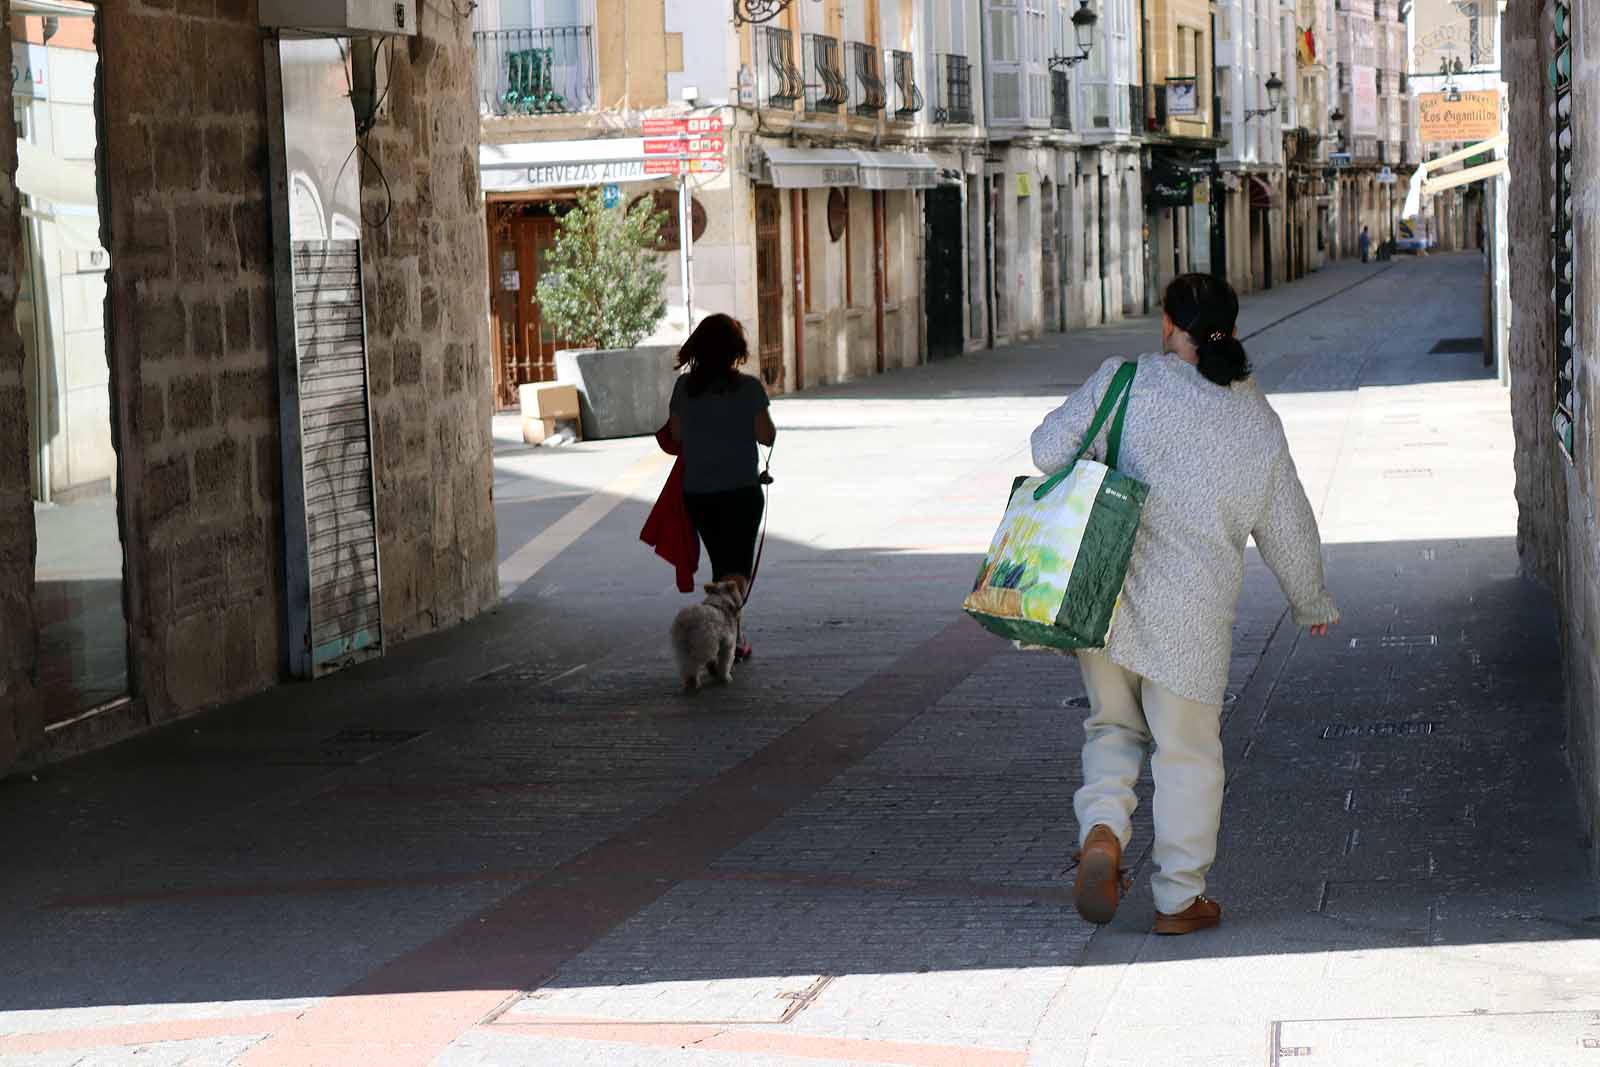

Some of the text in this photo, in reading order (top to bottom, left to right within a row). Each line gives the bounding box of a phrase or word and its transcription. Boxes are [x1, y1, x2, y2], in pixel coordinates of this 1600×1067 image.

[1424, 107, 1497, 125] Los Gigantillos
[527, 164, 597, 183] CERVEZAS
